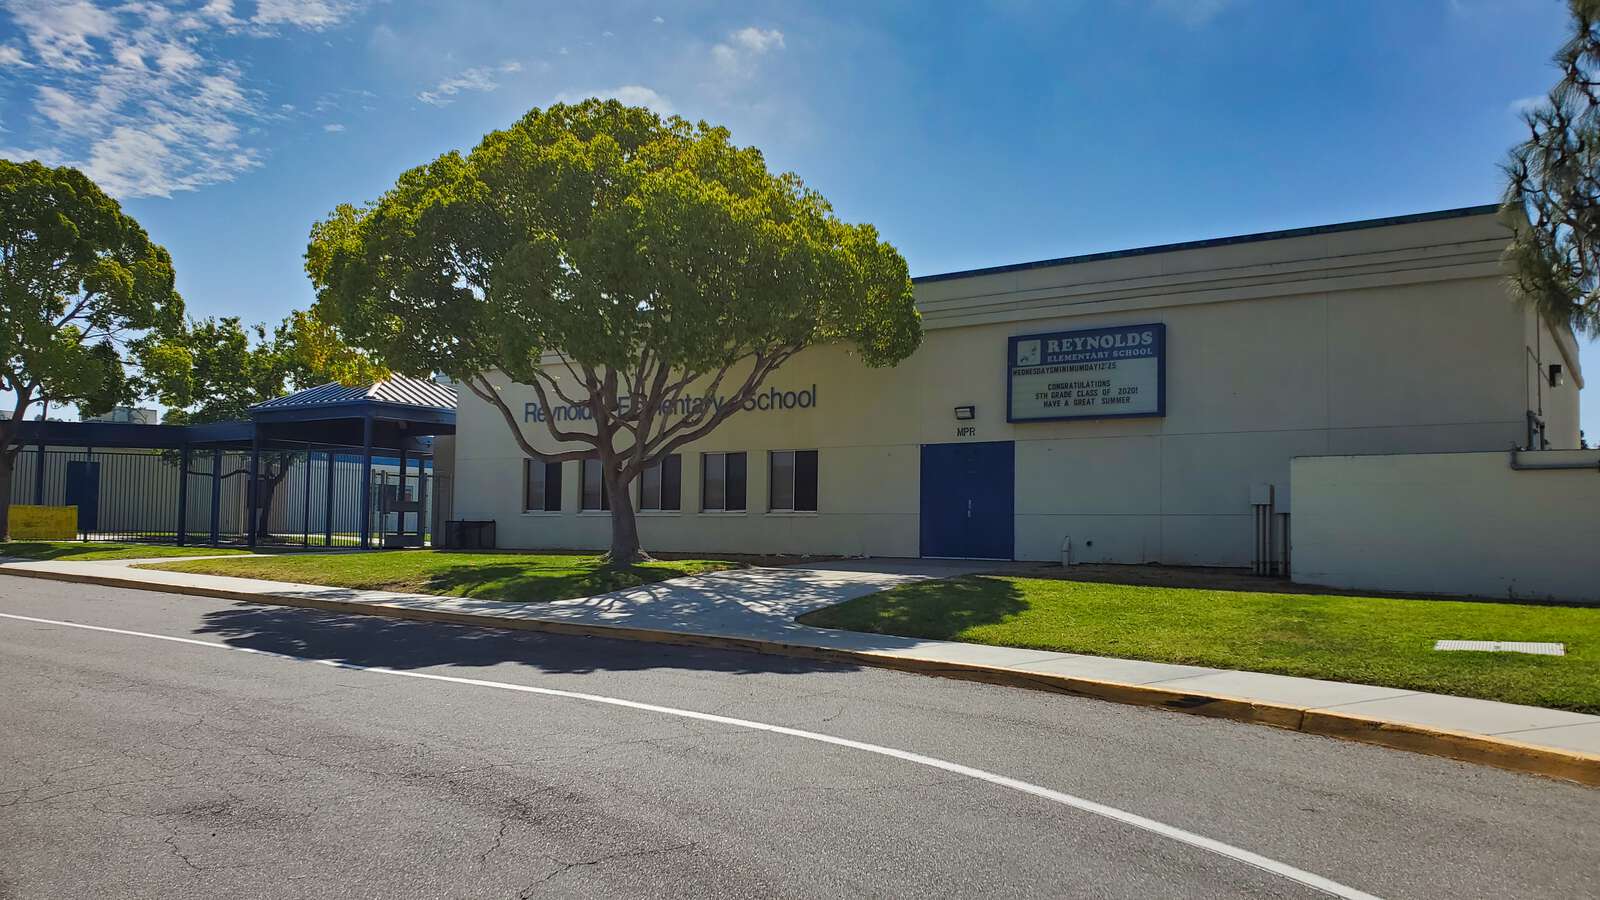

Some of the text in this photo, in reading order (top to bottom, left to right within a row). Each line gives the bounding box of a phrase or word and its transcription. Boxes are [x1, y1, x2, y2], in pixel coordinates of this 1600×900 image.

[1047, 331, 1153, 352] REYNOLDS
[1047, 348, 1153, 362] ELEMENTARY SCHOOL
[1047, 380, 1111, 391] CONGRATULATIONS
[1035, 392, 1048, 400] 5TH
[1051, 390, 1072, 399] GRADE
[1077, 389, 1098, 397] CLASS
[1118, 386, 1138, 395] 2020!
[1044, 400, 1060, 408] HAVE
[1074, 397, 1095, 406] GREAT
[1101, 396, 1131, 405] SUMMER
[957, 427, 975, 437] MPR
